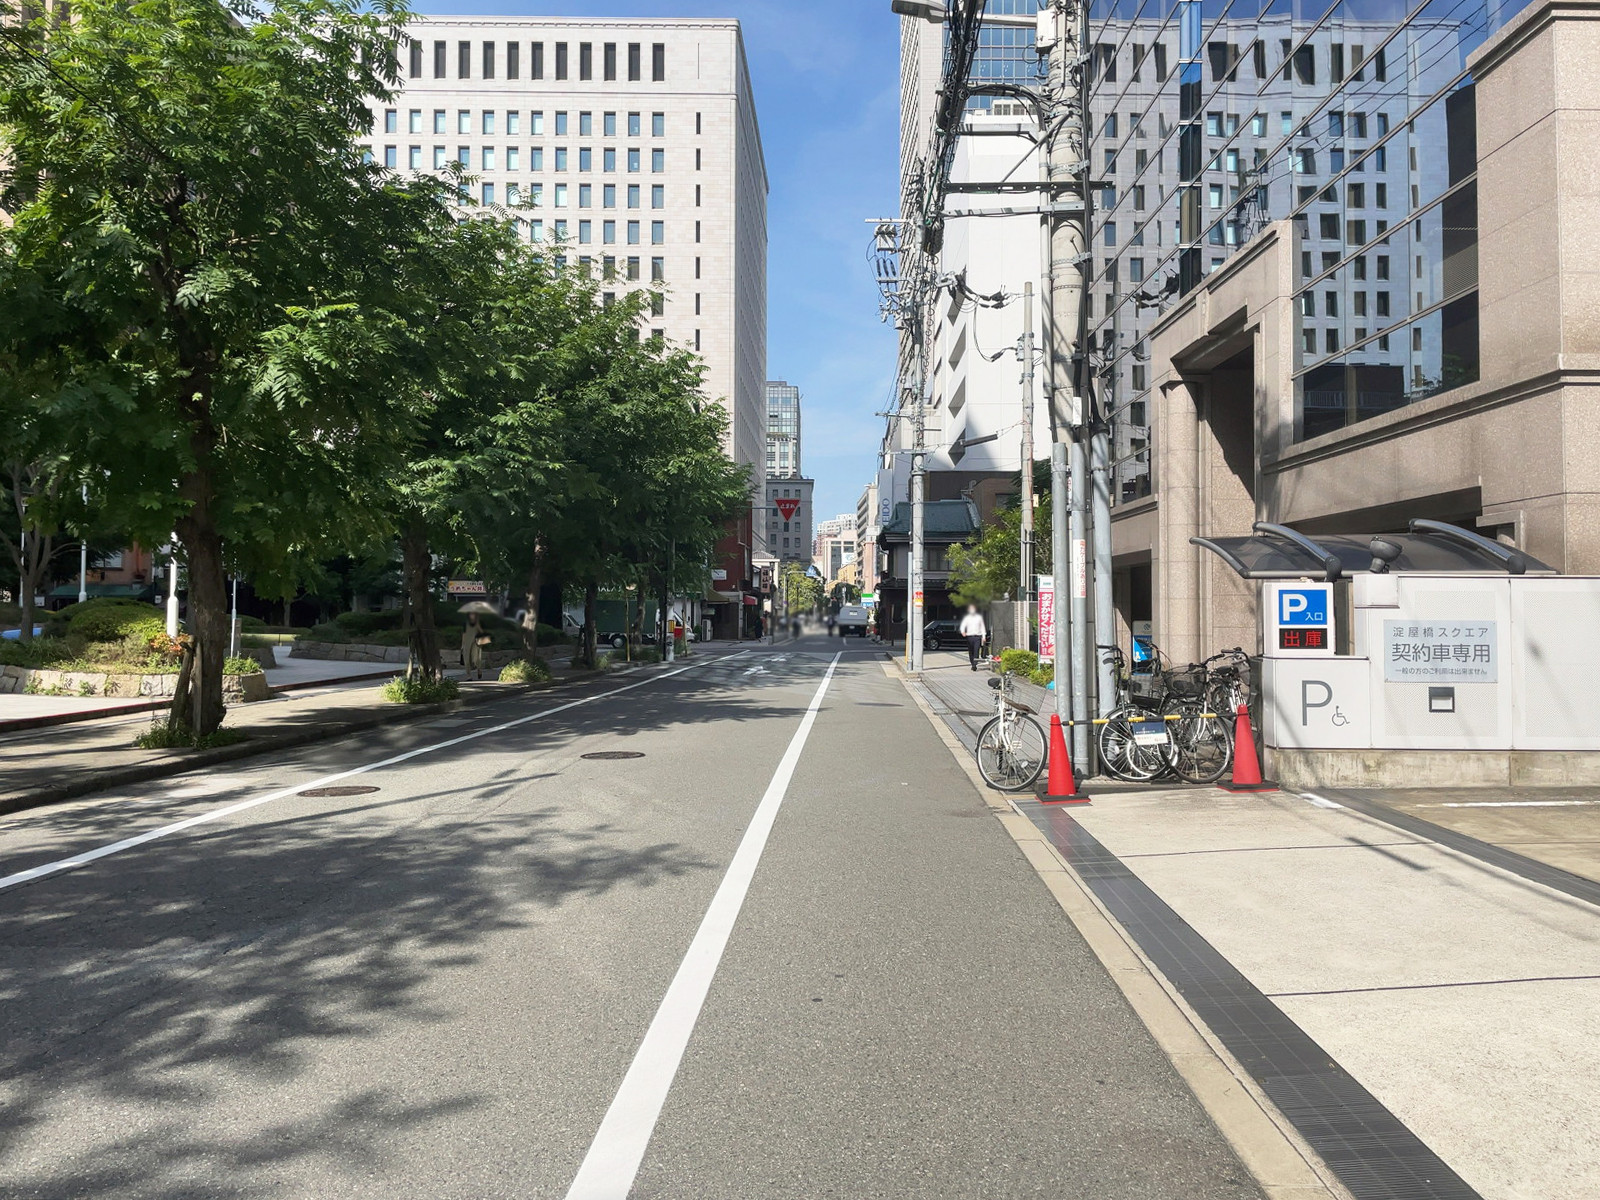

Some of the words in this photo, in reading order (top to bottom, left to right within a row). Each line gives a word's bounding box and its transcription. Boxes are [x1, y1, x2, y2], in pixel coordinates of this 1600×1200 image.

[1282, 593, 1308, 621] P
[1305, 612, 1323, 621] 入口
[1284, 630, 1322, 647] 出庫
[1393, 626, 1489, 638] 淀屋橋スクエア
[1391, 643, 1491, 663] 契約車専用
[1302, 680, 1333, 726] P
